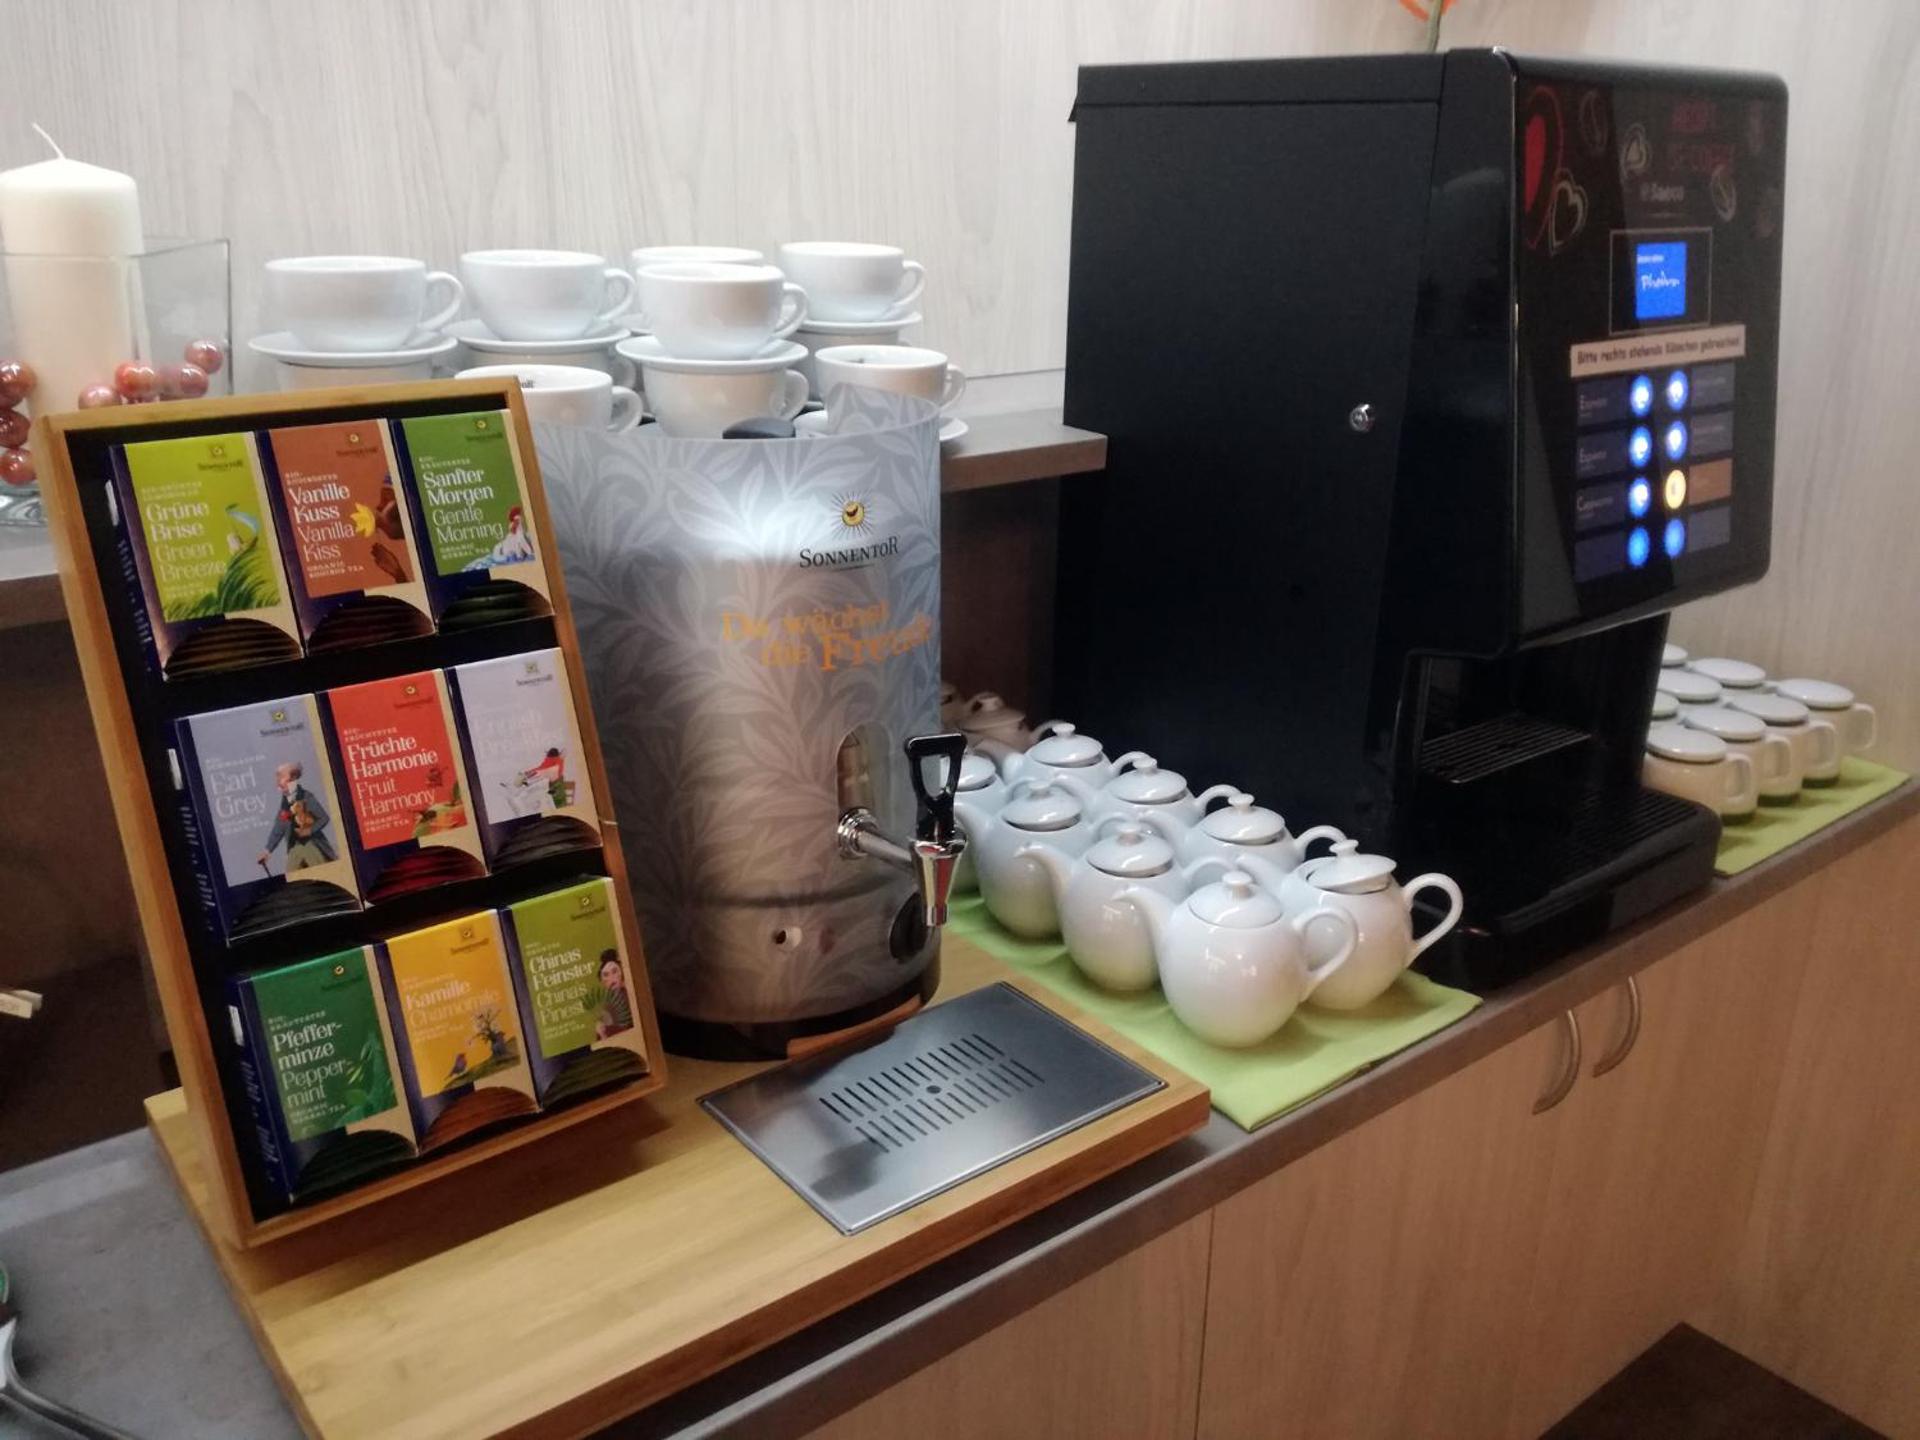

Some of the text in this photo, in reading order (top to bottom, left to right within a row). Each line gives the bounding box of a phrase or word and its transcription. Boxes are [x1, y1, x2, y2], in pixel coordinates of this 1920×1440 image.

[423, 468, 484, 489] Sanfter
[289, 483, 350, 505] Vanille
[427, 485, 494, 506] Morgen
[146, 501, 210, 524] Grüne
[293, 505, 340, 524] Kuss
[432, 506, 484, 527] Gentle
[150, 522, 205, 543] Brise
[298, 522, 356, 544] Vanilla
[436, 521, 503, 544] Morning
[155, 543, 214, 563] Green
[303, 543, 341, 562] Kiss
[799, 535, 899, 568] SONNENTOR
[160, 561, 226, 582] Breeze
[348, 736, 417, 762] Früchte
[351, 749, 438, 780] Harmonie
[210, 767, 257, 795] Earl
[356, 778, 396, 799] Fruit
[215, 792, 268, 819] Grey
[361, 789, 436, 818] Harmony
[529, 948, 582, 974] Chinas
[533, 961, 596, 991] Feinster
[405, 979, 471, 1010] Kamille
[541, 1000, 585, 1025] Finest
[273, 1021, 343, 1051] Pfeffer-
[278, 1041, 335, 1071] minze
[282, 1059, 353, 1090] Pepper-
[286, 1083, 326, 1109] mint
